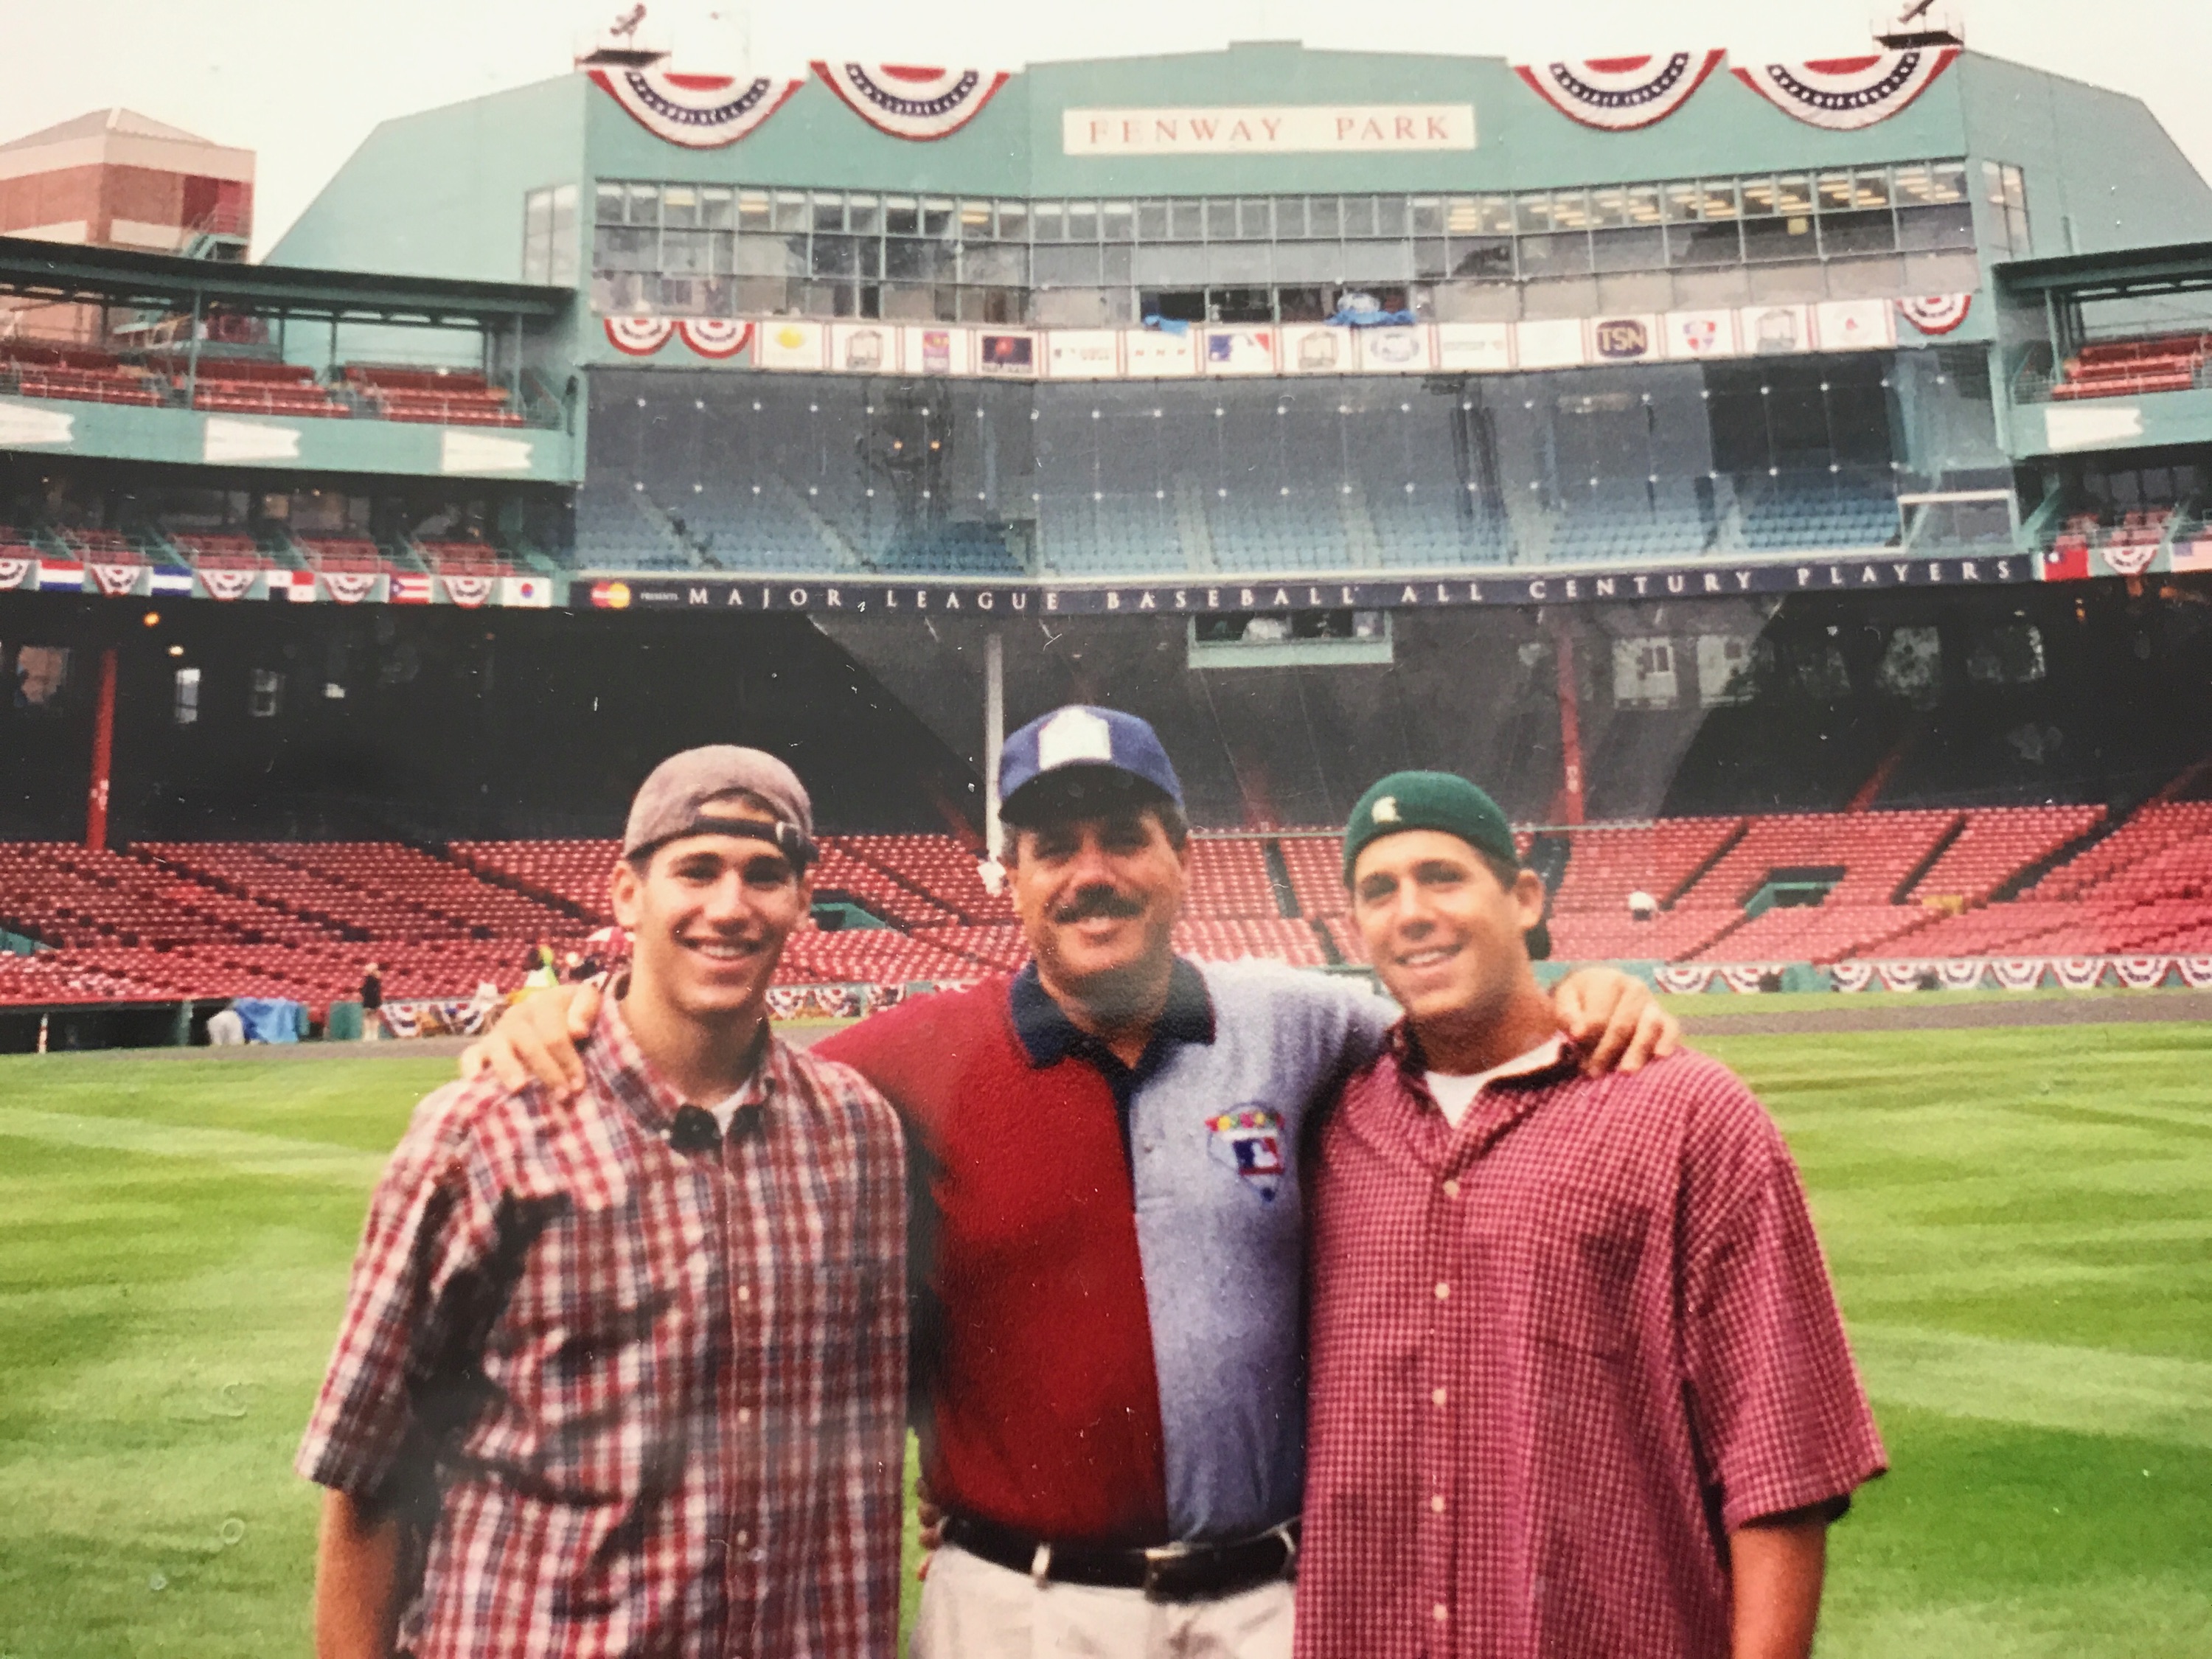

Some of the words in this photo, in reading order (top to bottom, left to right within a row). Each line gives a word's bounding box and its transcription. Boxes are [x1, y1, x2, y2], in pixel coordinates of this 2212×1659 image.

[1088, 118, 1282, 146] FENWAY
[1334, 114, 1450, 142] PARK
[1599, 327, 1646, 351] TSN
[689, 588, 842, 608] MAJOR
[887, 589, 1058, 611] LEAGUE
[1107, 587, 1354, 610] BASEBALL
[1402, 582, 1483, 602] ALL
[1528, 570, 1753, 599] CENTURY
[1798, 559, 2012, 587] PLAYERS
